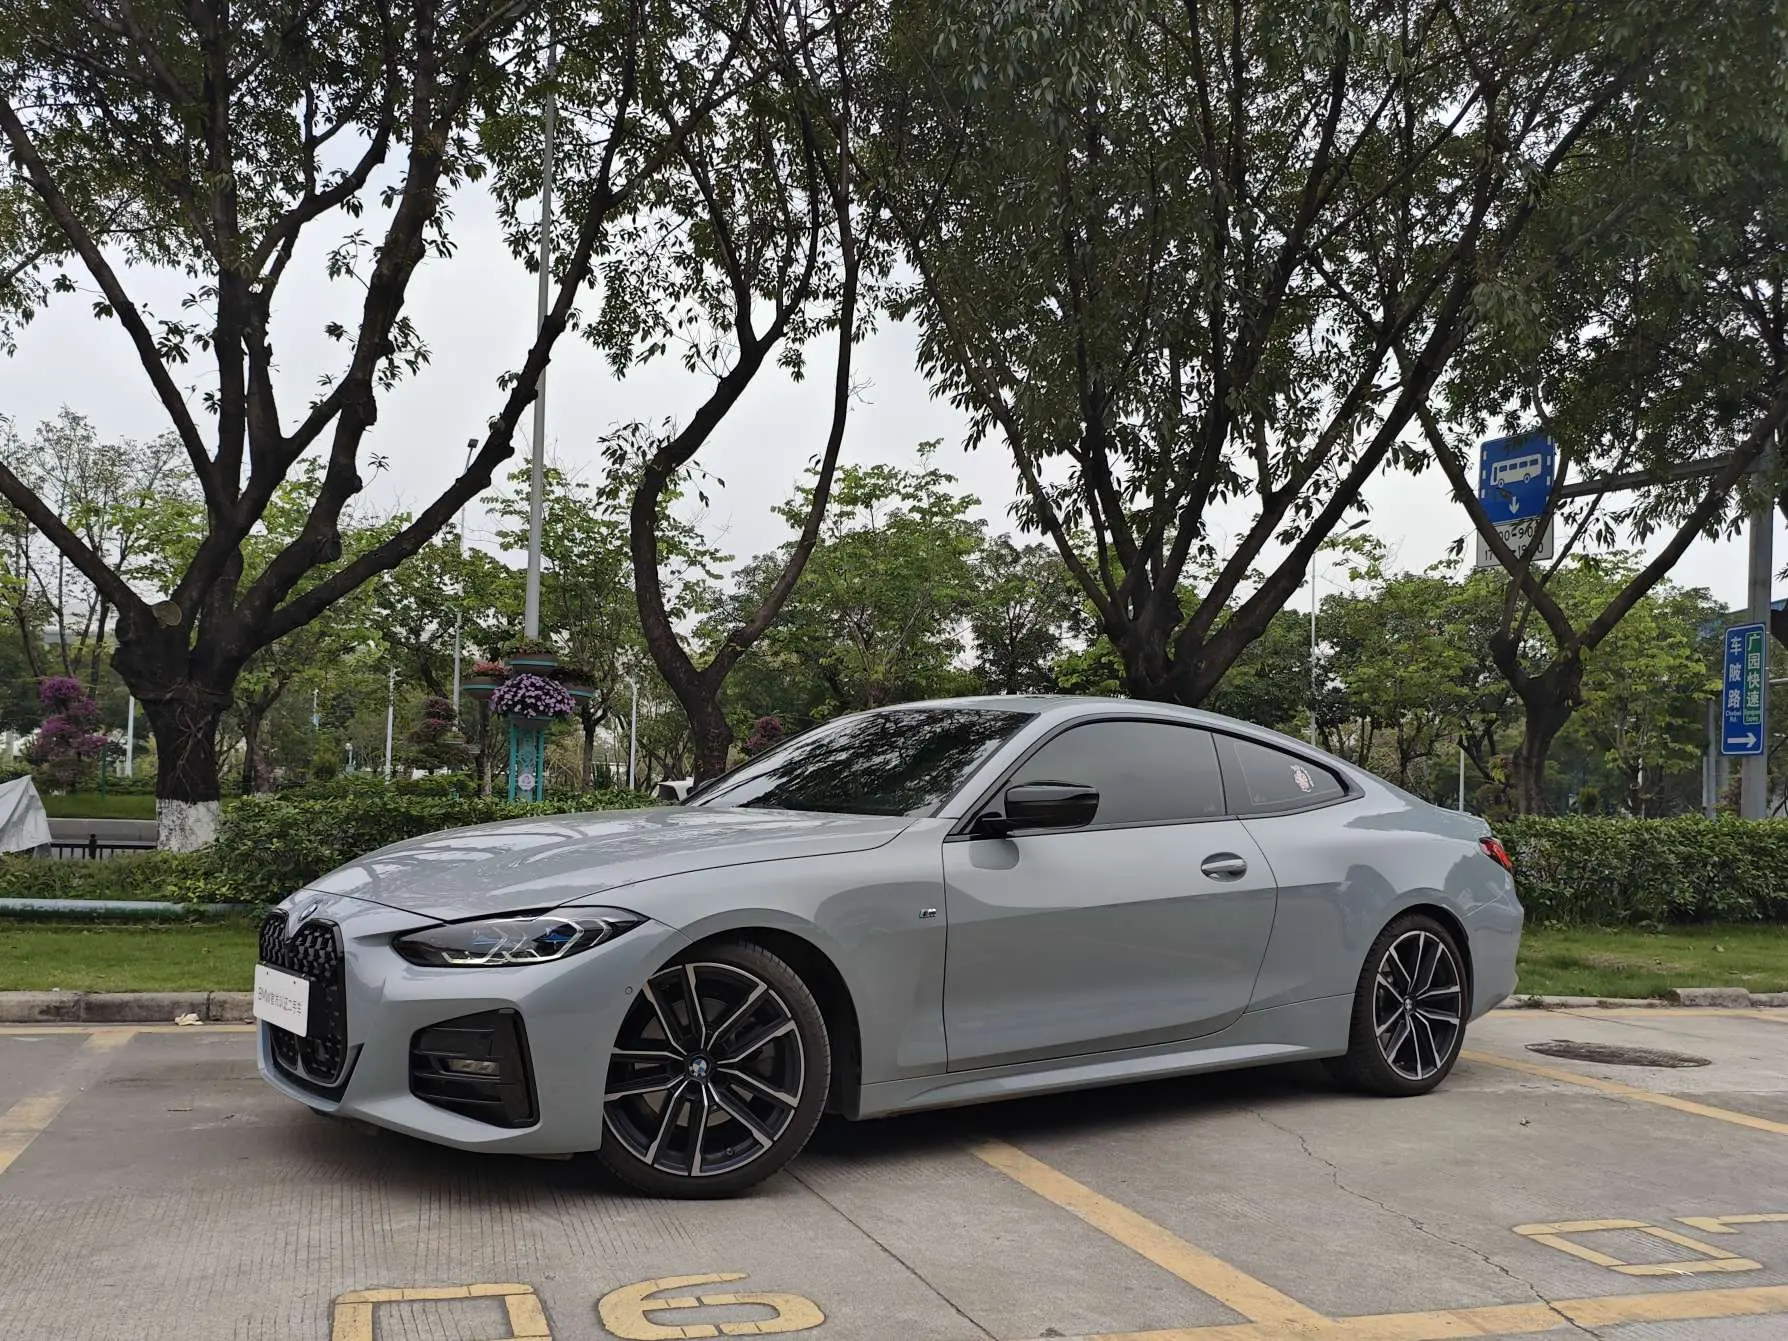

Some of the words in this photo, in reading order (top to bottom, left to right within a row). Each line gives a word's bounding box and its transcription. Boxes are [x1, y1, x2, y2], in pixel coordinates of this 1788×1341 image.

[1728, 636, 1742, 709] 车陂路
[1746, 633, 1760, 708] 广园快速
